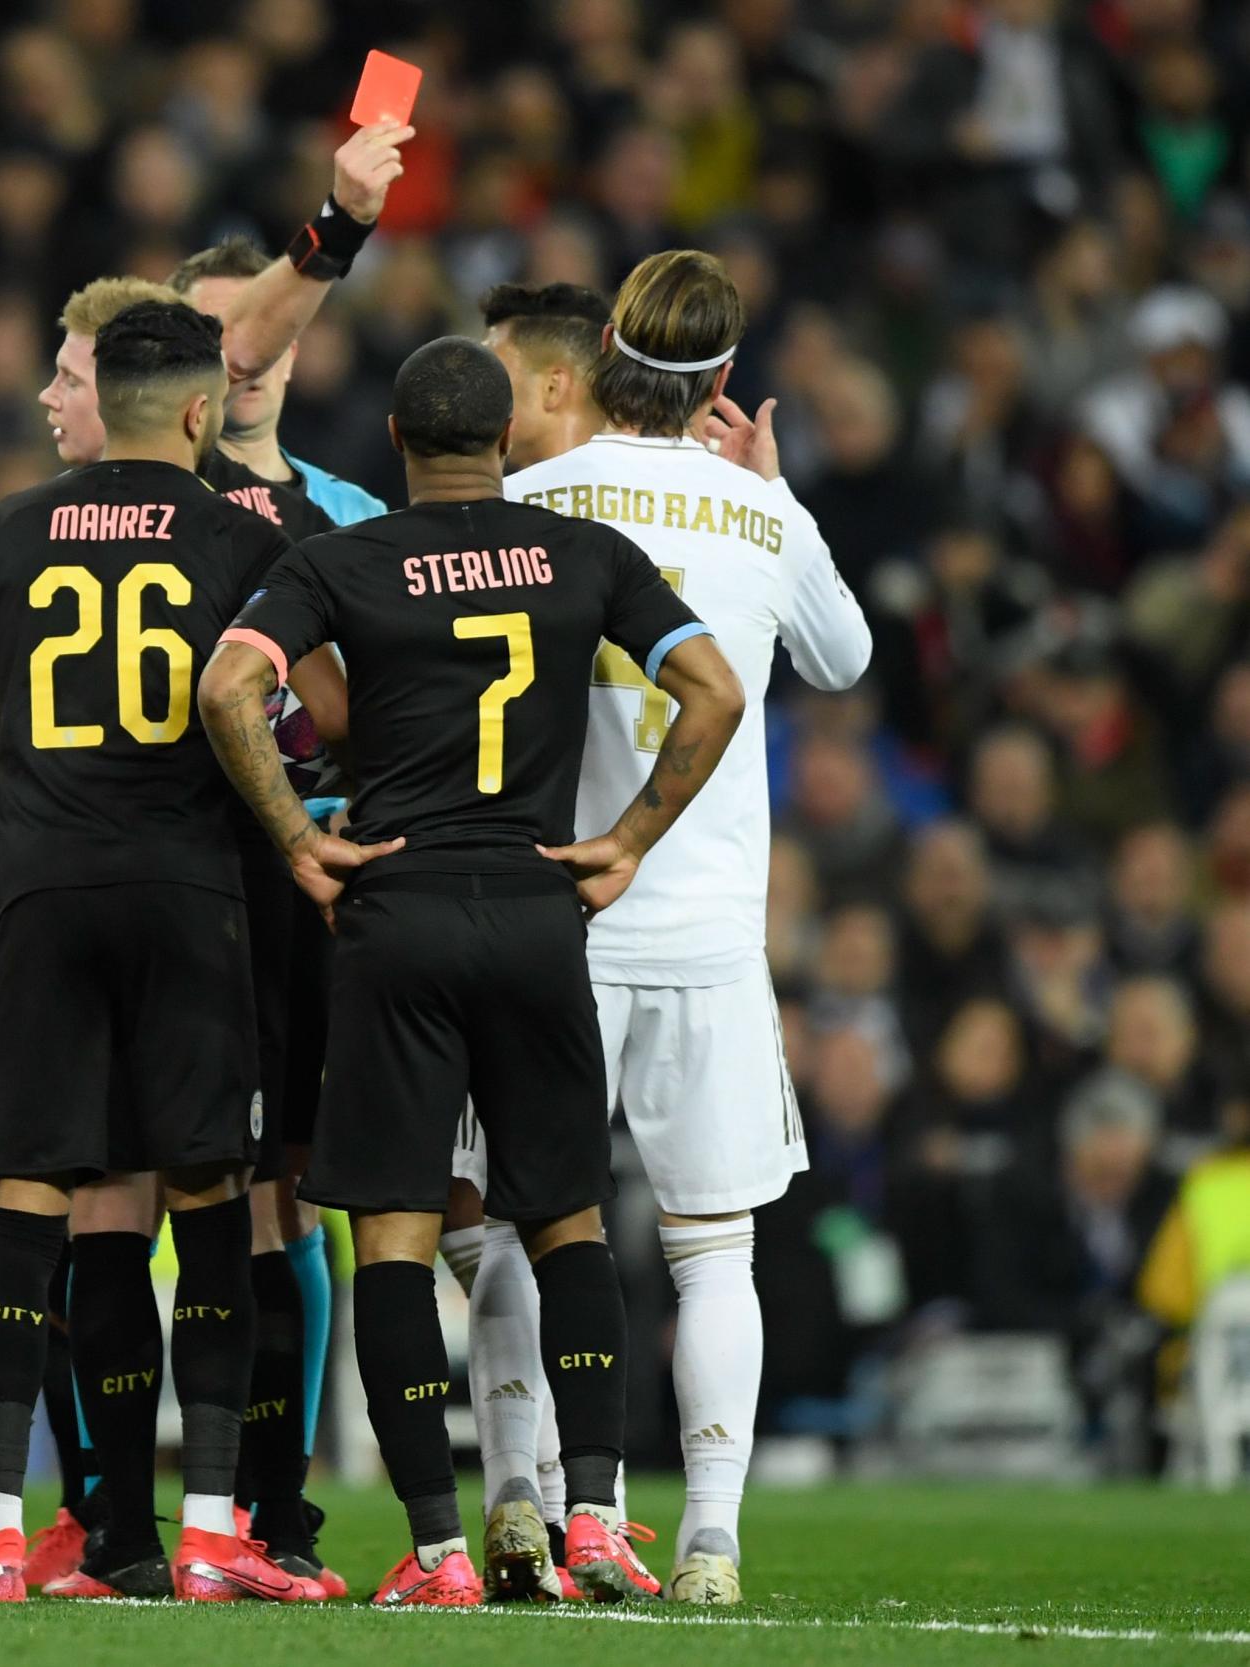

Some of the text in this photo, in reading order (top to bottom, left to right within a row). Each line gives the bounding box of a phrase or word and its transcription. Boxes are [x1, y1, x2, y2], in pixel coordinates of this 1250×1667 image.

[49, 503, 176, 541] MAHREZ
[663, 491, 784, 556] RAMOS
[403, 546, 554, 596] STERLING
[29, 563, 193, 749] 26
[453, 611, 535, 794] 7
[174, 1305, 232, 1321] CITY
[558, 1352, 615, 1370] CITY
[102, 1367, 156, 1395] CITY
[404, 1380, 450, 1401] CITY
[243, 1398, 286, 1423] CITY
